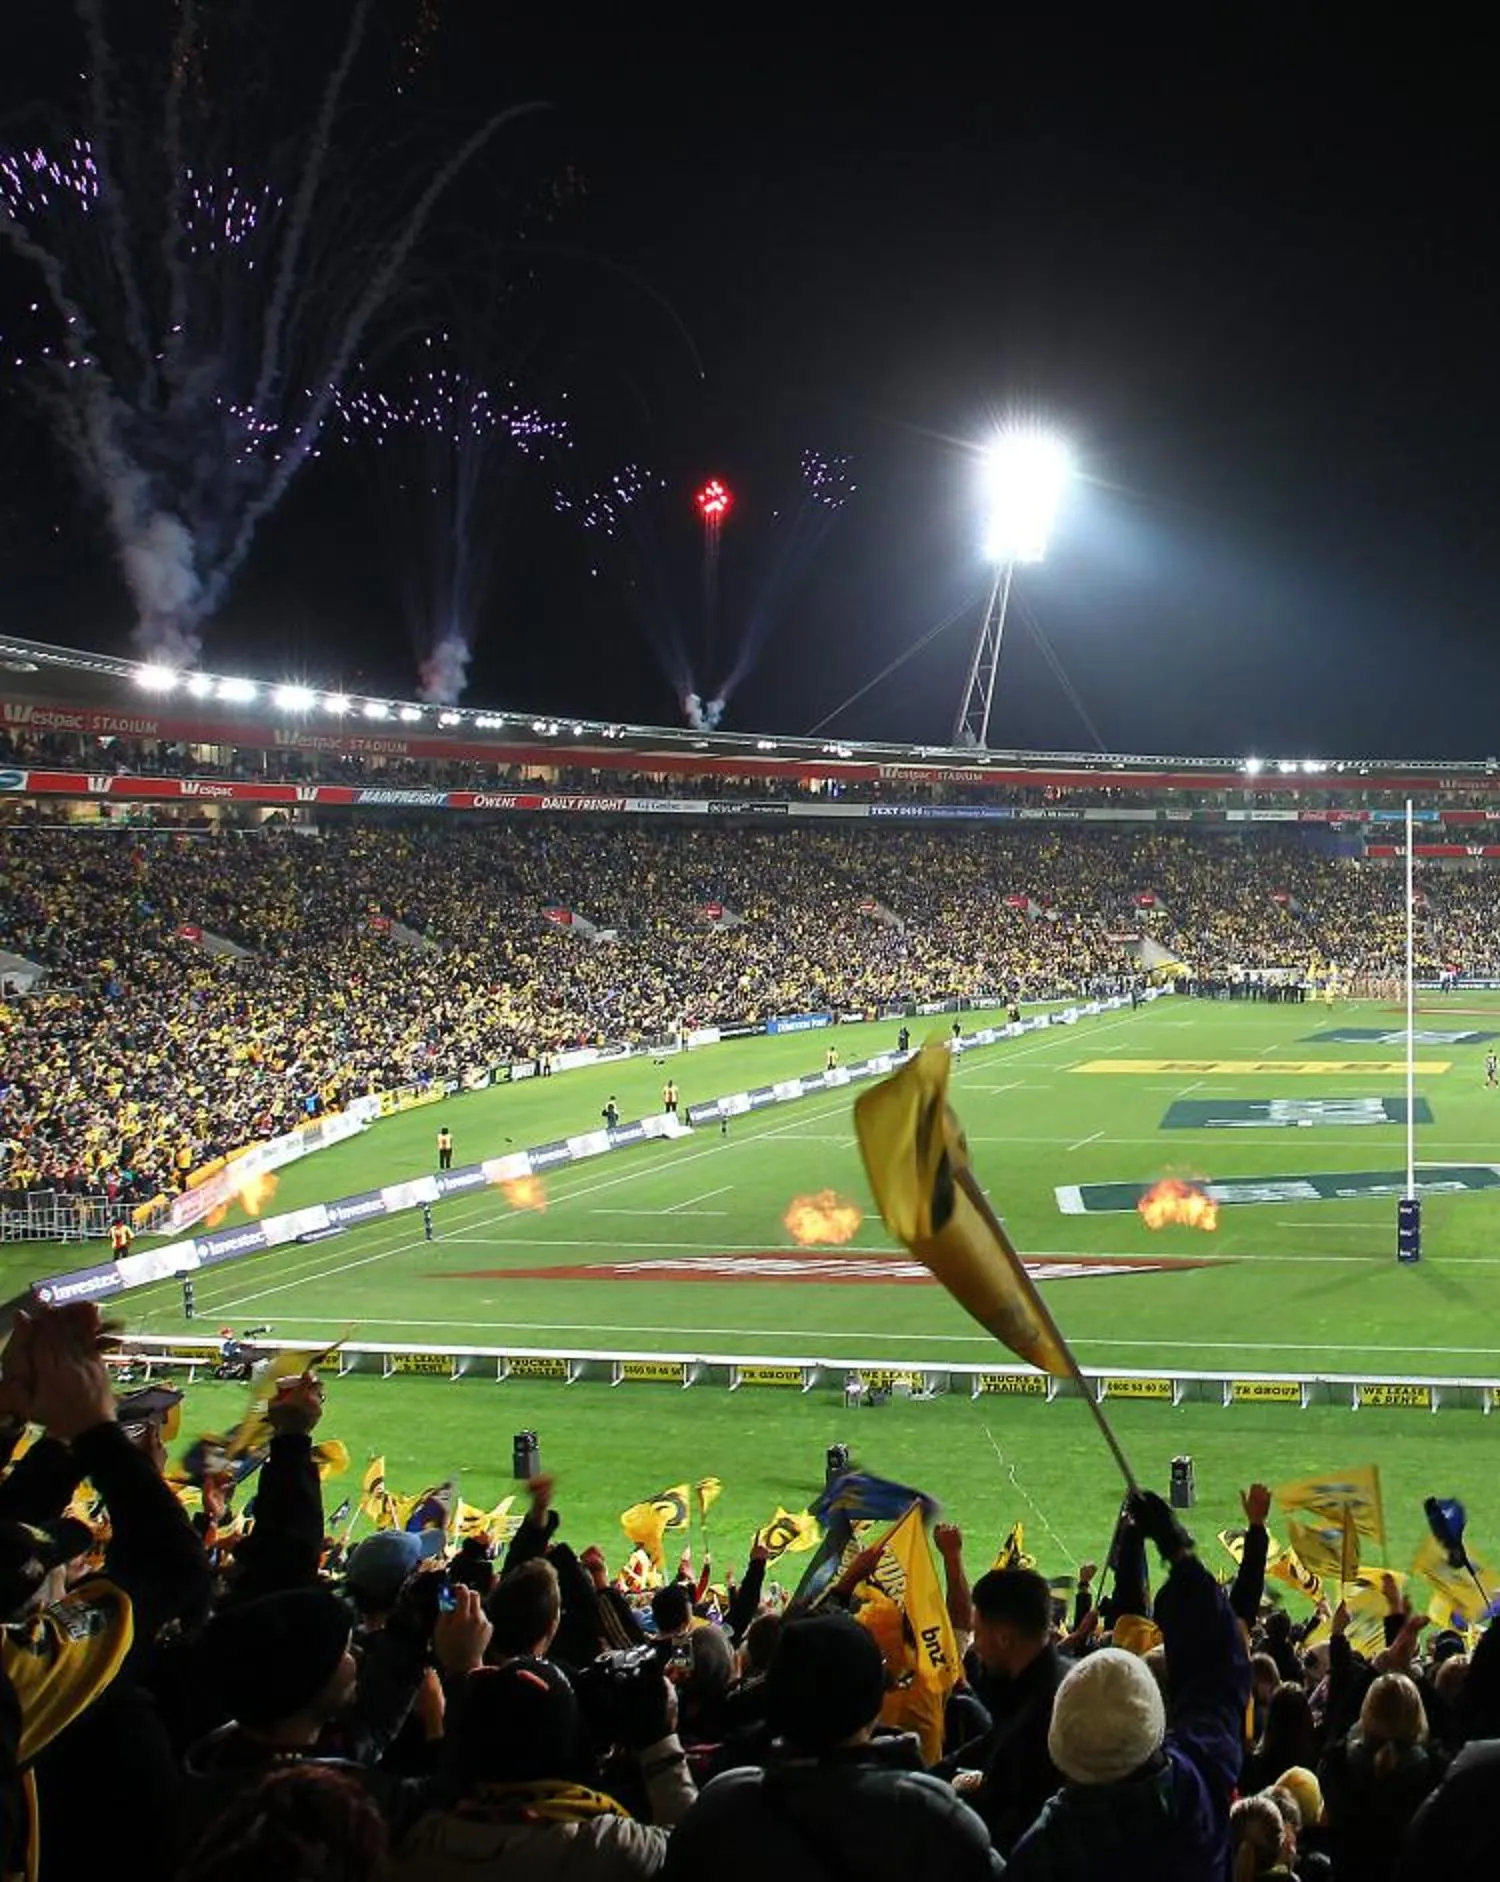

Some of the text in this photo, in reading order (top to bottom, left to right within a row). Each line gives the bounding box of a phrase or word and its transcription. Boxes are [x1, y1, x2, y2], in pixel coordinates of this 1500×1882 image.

[4, 704, 159, 733] Westpac STADIUM
[180, 781, 233, 797] Westpac
[358, 790, 447, 804] MAINFREIGHT
[541, 797, 578, 810] DAILY
[577, 799, 624, 811] FREIGHT
[872, 807, 899, 816] TEXT
[1363, 1386, 1383, 1395] WE
[921, 1626, 947, 1668] bnz
